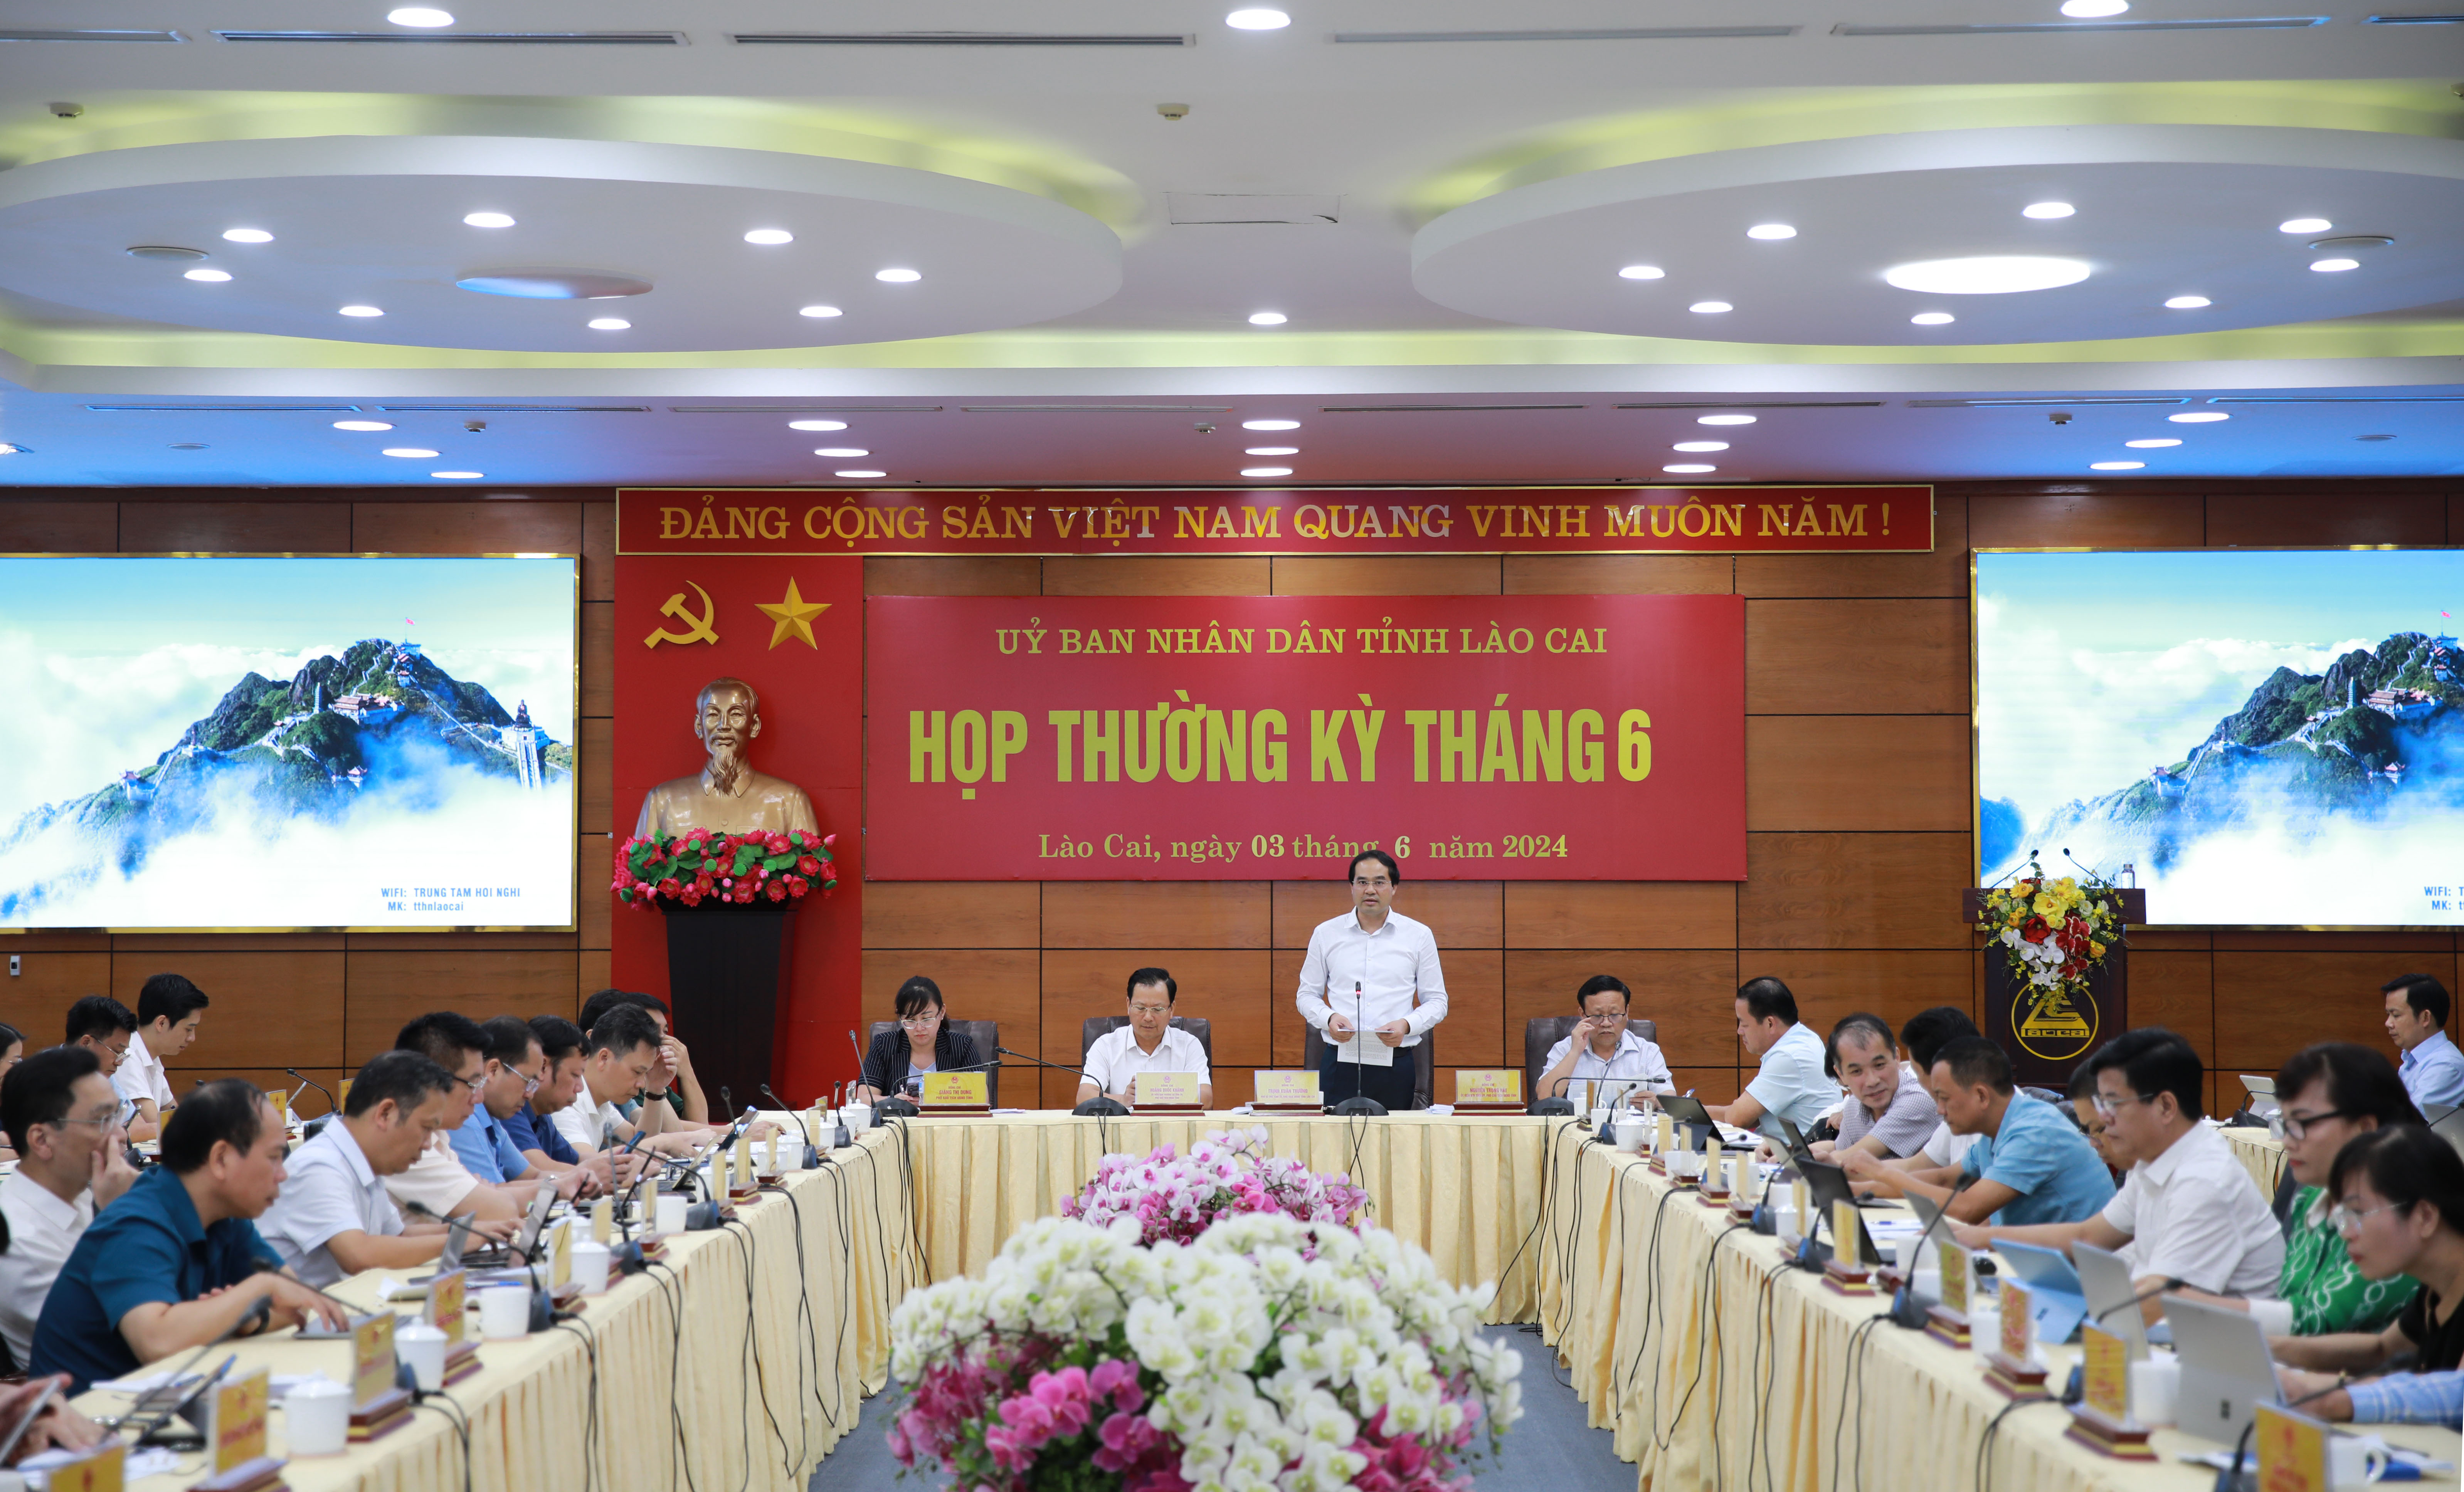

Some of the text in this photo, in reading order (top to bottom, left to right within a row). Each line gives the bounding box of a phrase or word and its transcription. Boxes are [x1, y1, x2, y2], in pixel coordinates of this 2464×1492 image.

[660, 495, 790, 539] ĐẢNG
[804, 496, 929, 547] CỘNG
[943, 494, 1035, 538] SẢN
[1048, 497, 1159, 546] VIỆT
[1174, 506, 1282, 538] NAM
[1293, 504, 1453, 540] QUANG
[1472, 505, 1591, 537] VINH
[1604, 496, 1746, 538] MUÔN
[1758, 496, 1868, 536] NĂM
[996, 617, 1608, 654] UỶ BAN NHÂN DÂN TỈNH LÀO CAI
[910, 689, 1652, 800] HỌP THƯỜNG KỲ THÁNG 6
[1038, 834, 1093, 858] Lào
[1104, 833, 1161, 863] Cai,
[1170, 834, 1242, 863] ngày
[1251, 834, 1285, 858] 03
[1394, 835, 1411, 858] 6
[1429, 835, 1494, 859] năm
[1502, 834, 1568, 858] 2024
[381, 888, 520, 897] WIFI: TRUNG TAM HOI NGHI
[2424, 886, 2451, 896] WIFI:
[388, 901, 463, 911] MK: tthnlaocai
[2432, 900, 2451, 910] MK:
